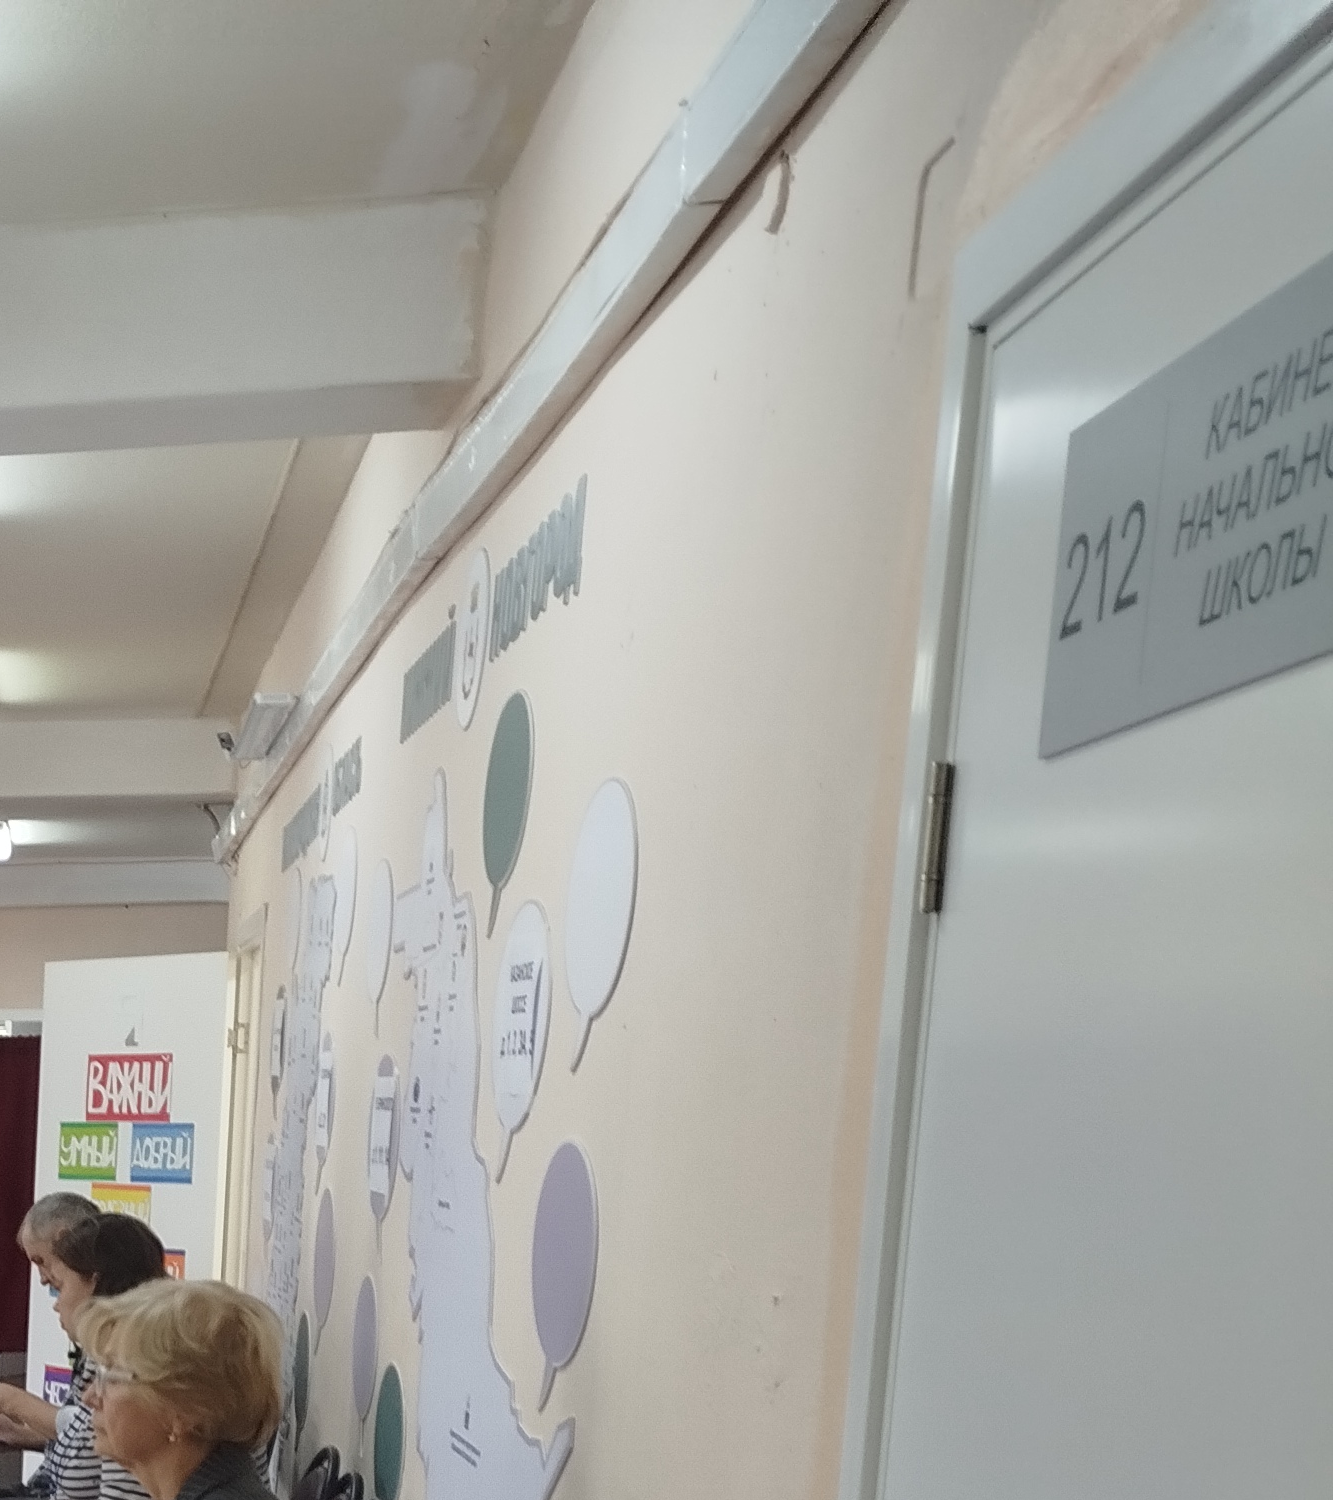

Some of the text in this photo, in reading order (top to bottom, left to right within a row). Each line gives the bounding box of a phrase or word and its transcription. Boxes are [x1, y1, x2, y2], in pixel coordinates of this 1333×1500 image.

[1058, 499, 1146, 641] 212
[1198, 513, 1327, 627] ШКОЛЫ
[88, 1054, 171, 1115] ВАЖНЫЙ
[60, 1131, 117, 1168] УМНЫЙ
[132, 1132, 191, 1170] ДОБРЫЙ
